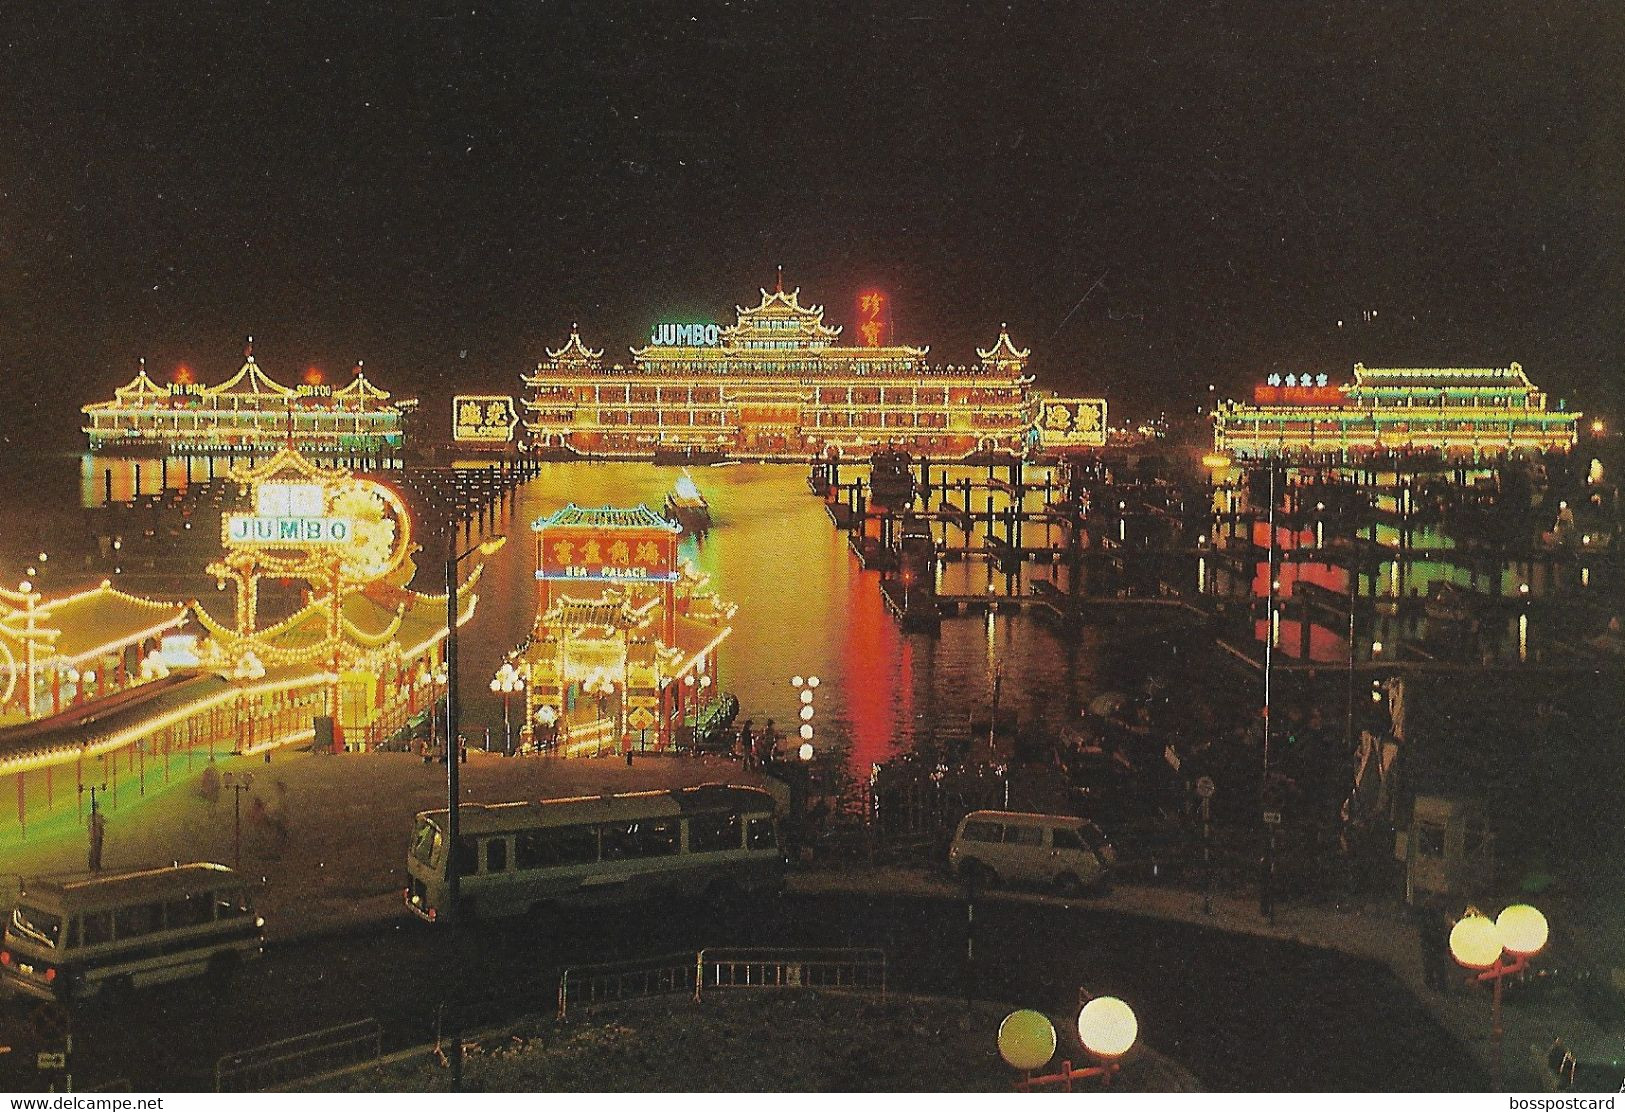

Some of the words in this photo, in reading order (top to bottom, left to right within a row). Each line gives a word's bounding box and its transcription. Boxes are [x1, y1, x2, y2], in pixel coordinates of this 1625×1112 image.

[651, 324, 718, 346] JUMBO
[233, 520, 347, 540] JUMBO
[565, 565, 589, 578] SEA
[600, 565, 647, 578] PALACE
